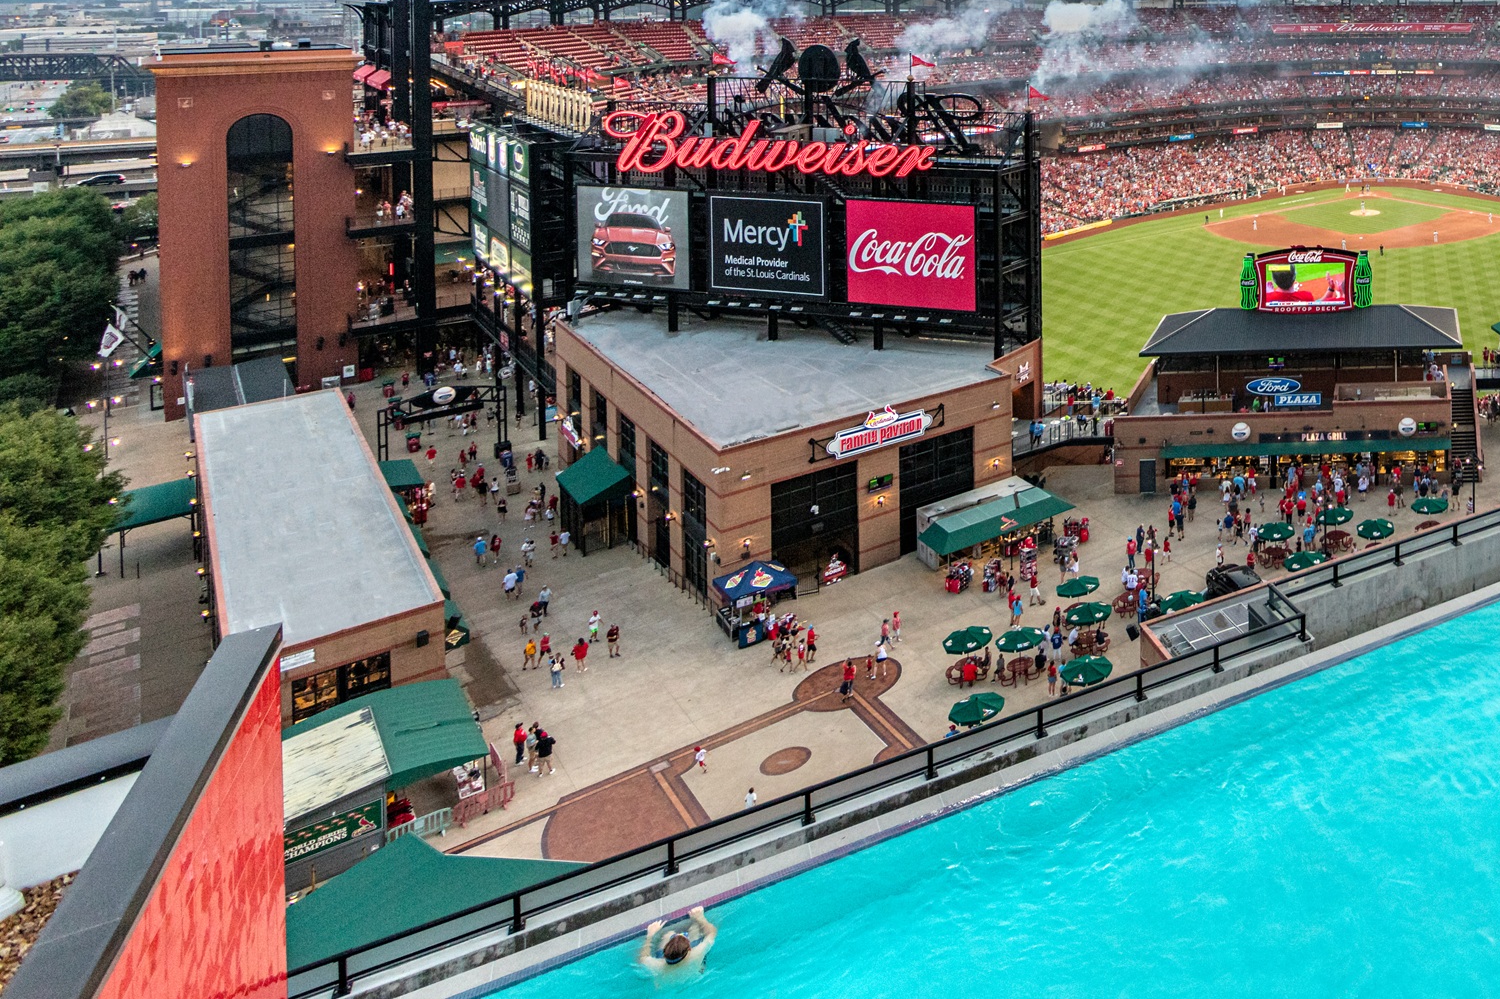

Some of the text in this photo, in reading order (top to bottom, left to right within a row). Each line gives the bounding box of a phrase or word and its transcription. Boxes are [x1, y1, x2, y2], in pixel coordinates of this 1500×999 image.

[1335, 23, 1413, 33] Budweiser
[604, 110, 936, 178] Budweiser
[594, 187, 671, 225] Ford
[723, 218, 790, 251] Mercy
[724, 254, 789, 268] Medical Provider
[848, 228, 973, 280] Coca-Cola
[1288, 250, 1323, 263] Coca-Cola
[724, 267, 811, 282] of the St. Louis Cardinals
[1274, 305, 1313, 313] ROOFTOP
[1257, 380, 1290, 392] Ford
[1279, 395, 1317, 404] PLAZA
[840, 429, 878, 451] Family
[1301, 432, 1347, 442] PLAZA GRILL
[317, 827, 347, 841] SERIES
